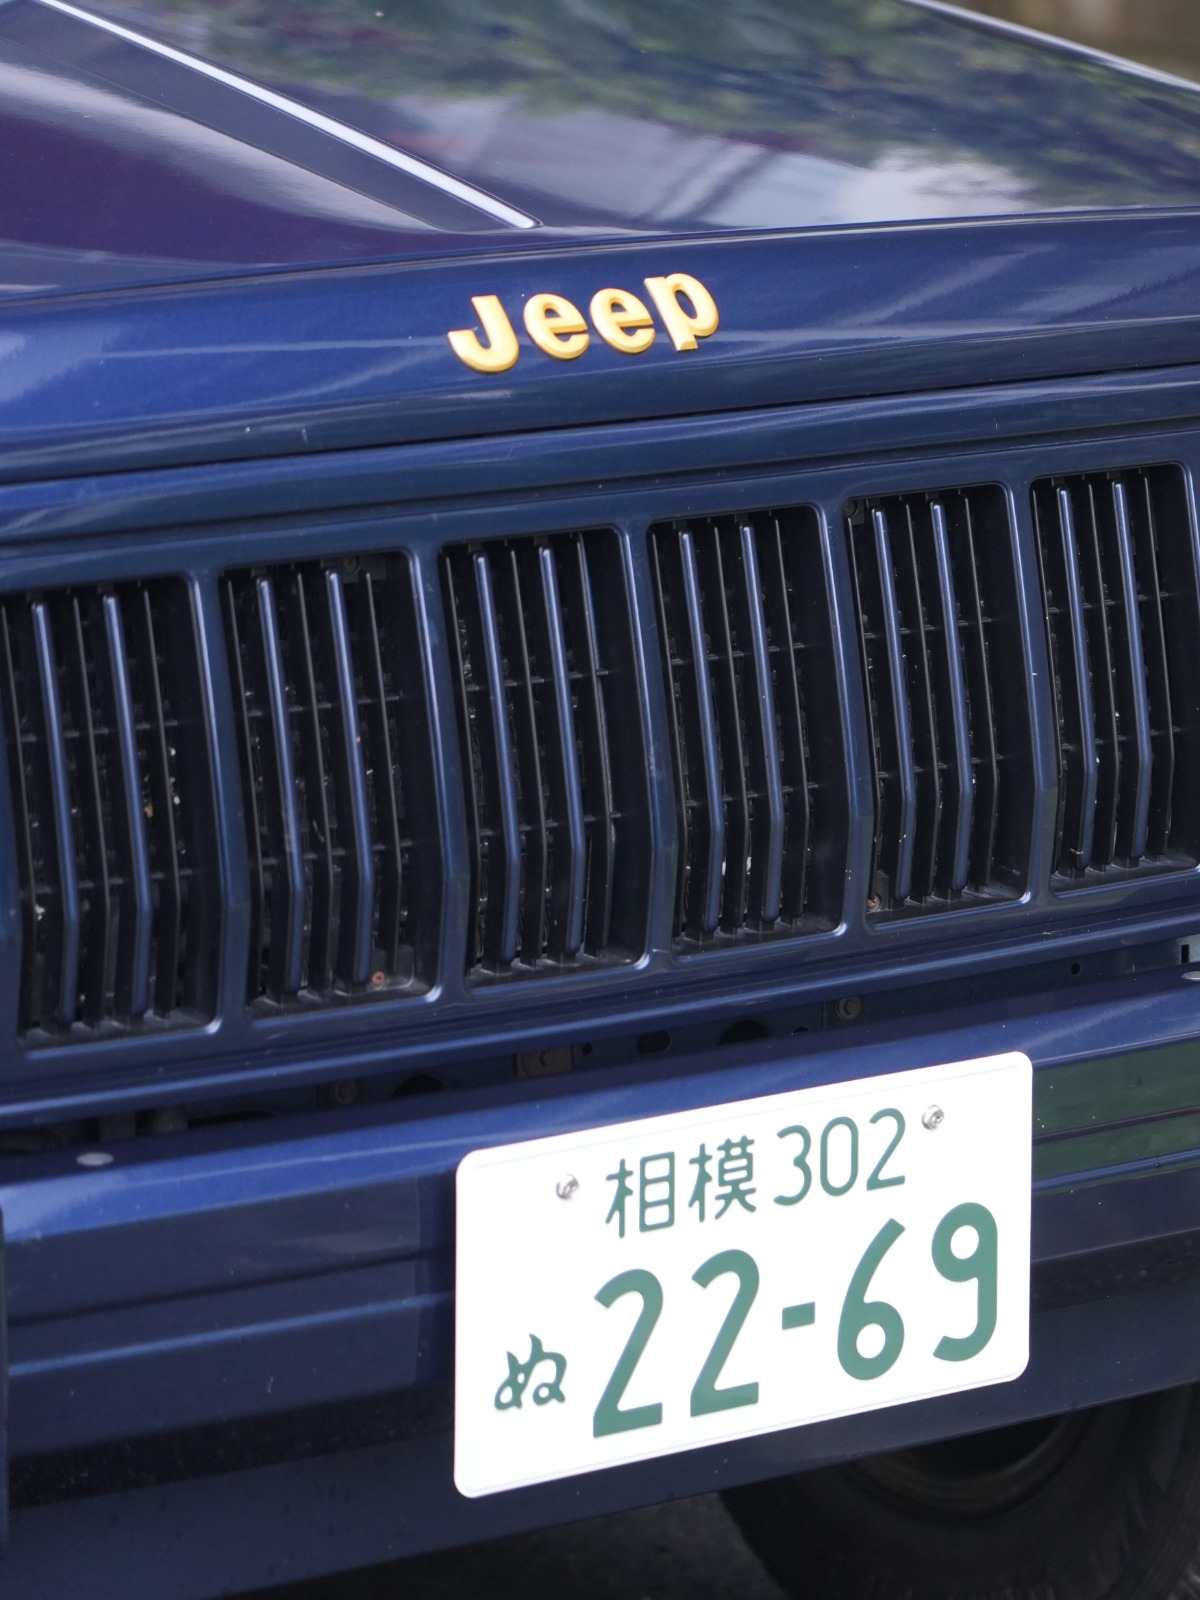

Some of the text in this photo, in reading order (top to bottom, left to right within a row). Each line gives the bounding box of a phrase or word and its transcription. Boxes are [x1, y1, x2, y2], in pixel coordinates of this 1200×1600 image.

[447, 273, 719, 373] Jeep
[605, 1107, 906, 1239] 相模 302
[494, 1202, 998, 1439] ぬ 22-69
